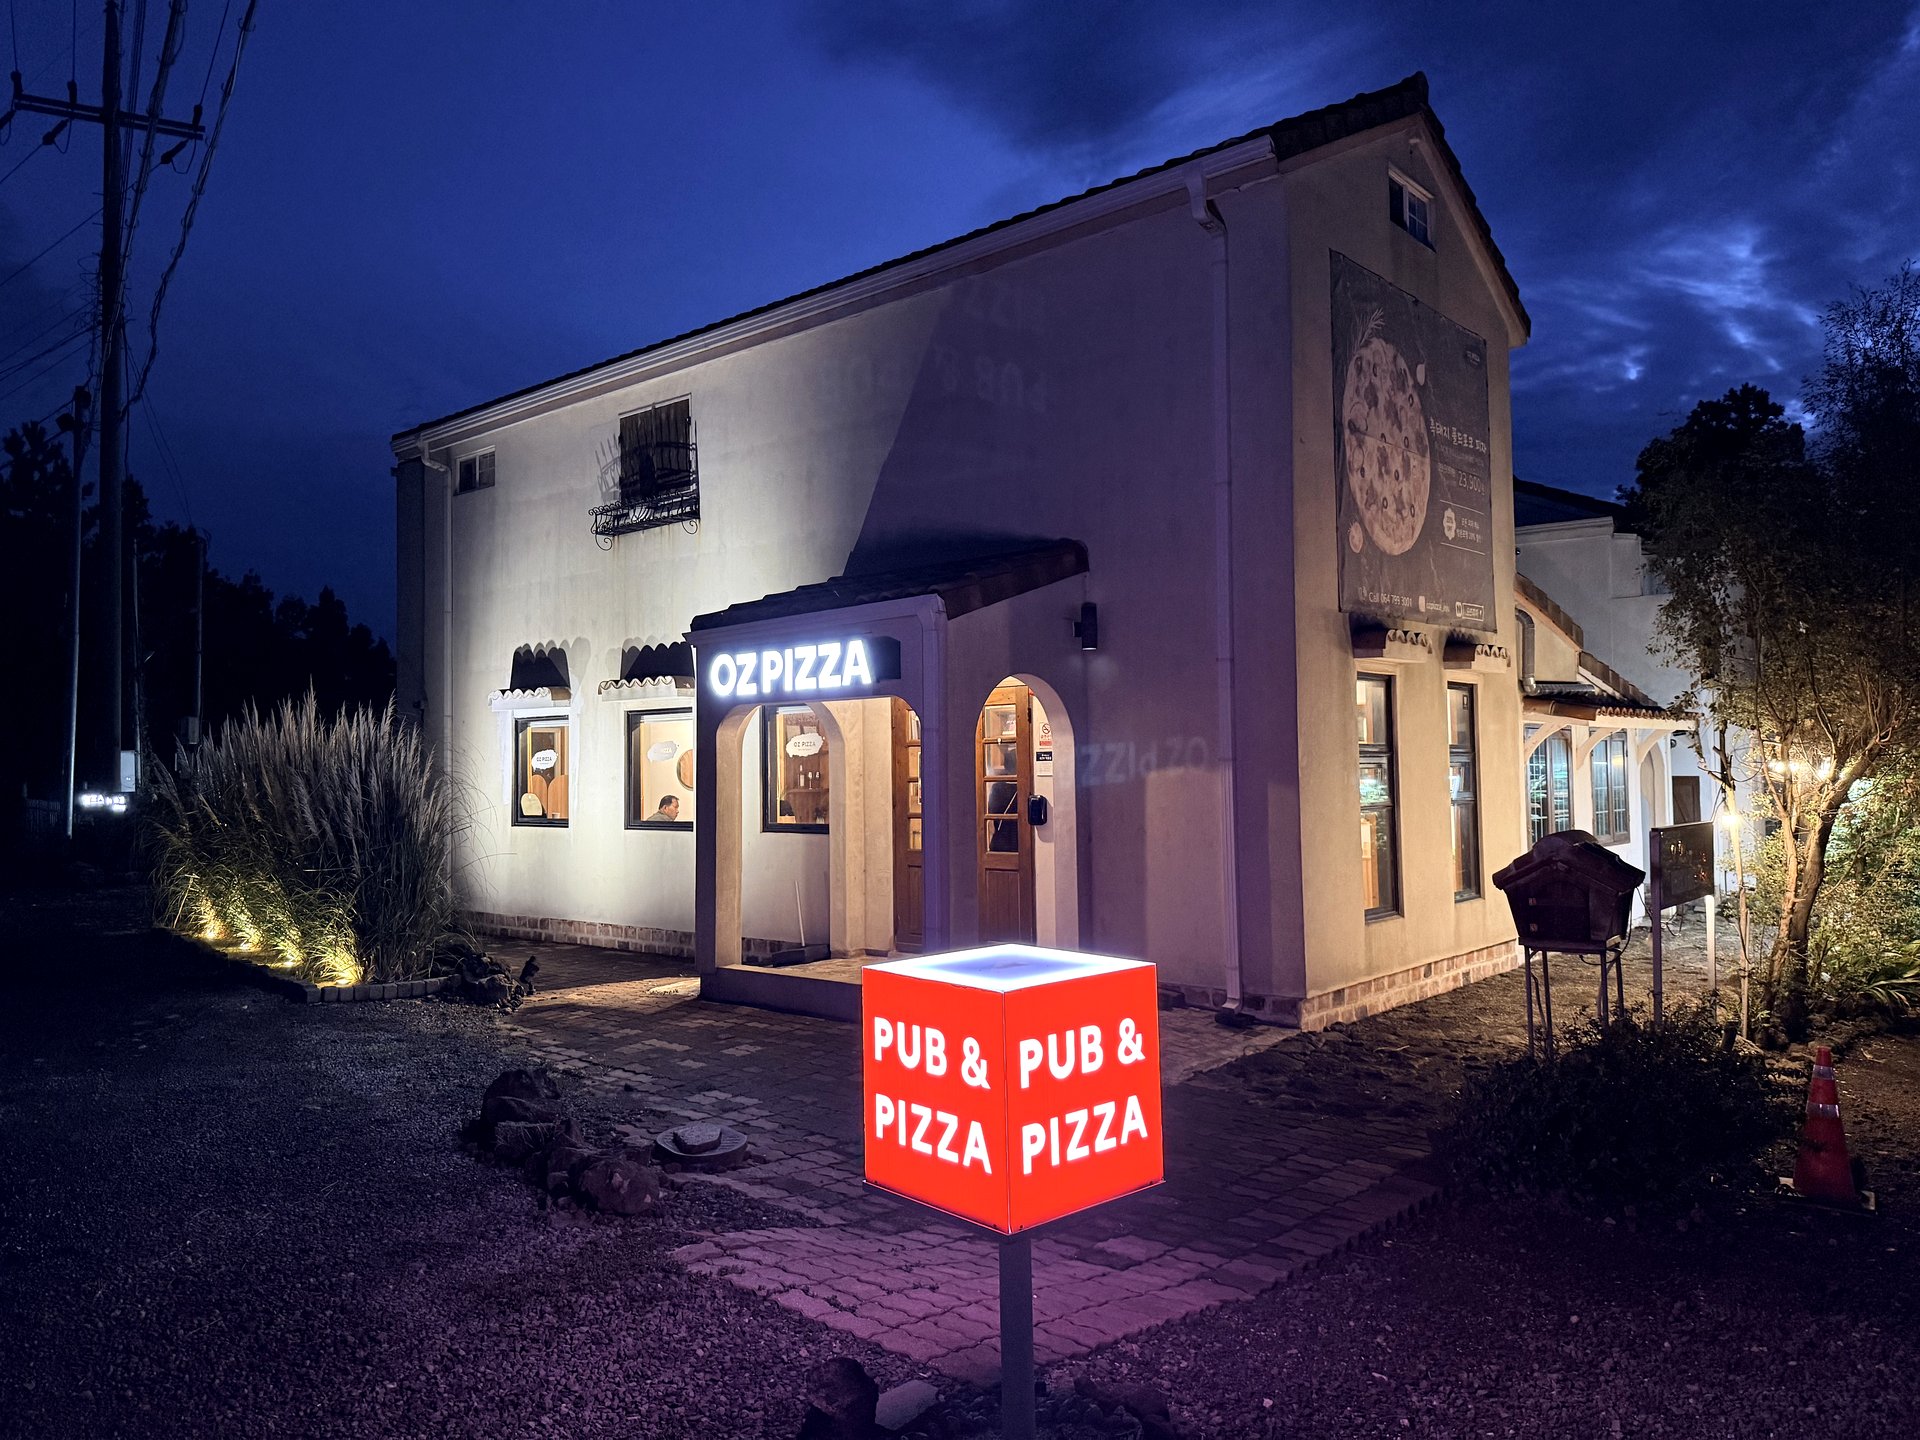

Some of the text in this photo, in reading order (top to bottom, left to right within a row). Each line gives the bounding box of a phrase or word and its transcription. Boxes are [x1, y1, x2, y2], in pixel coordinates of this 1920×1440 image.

[1369, 592, 1379, 603] Call
[710, 639, 872, 696] OZ PIZZA
[874, 1017, 991, 1089] PUB &
[1019, 1017, 1146, 1089] PUB &
[875, 1093, 992, 1174] PIZZA
[1022, 1095, 1148, 1175] PIZZA
